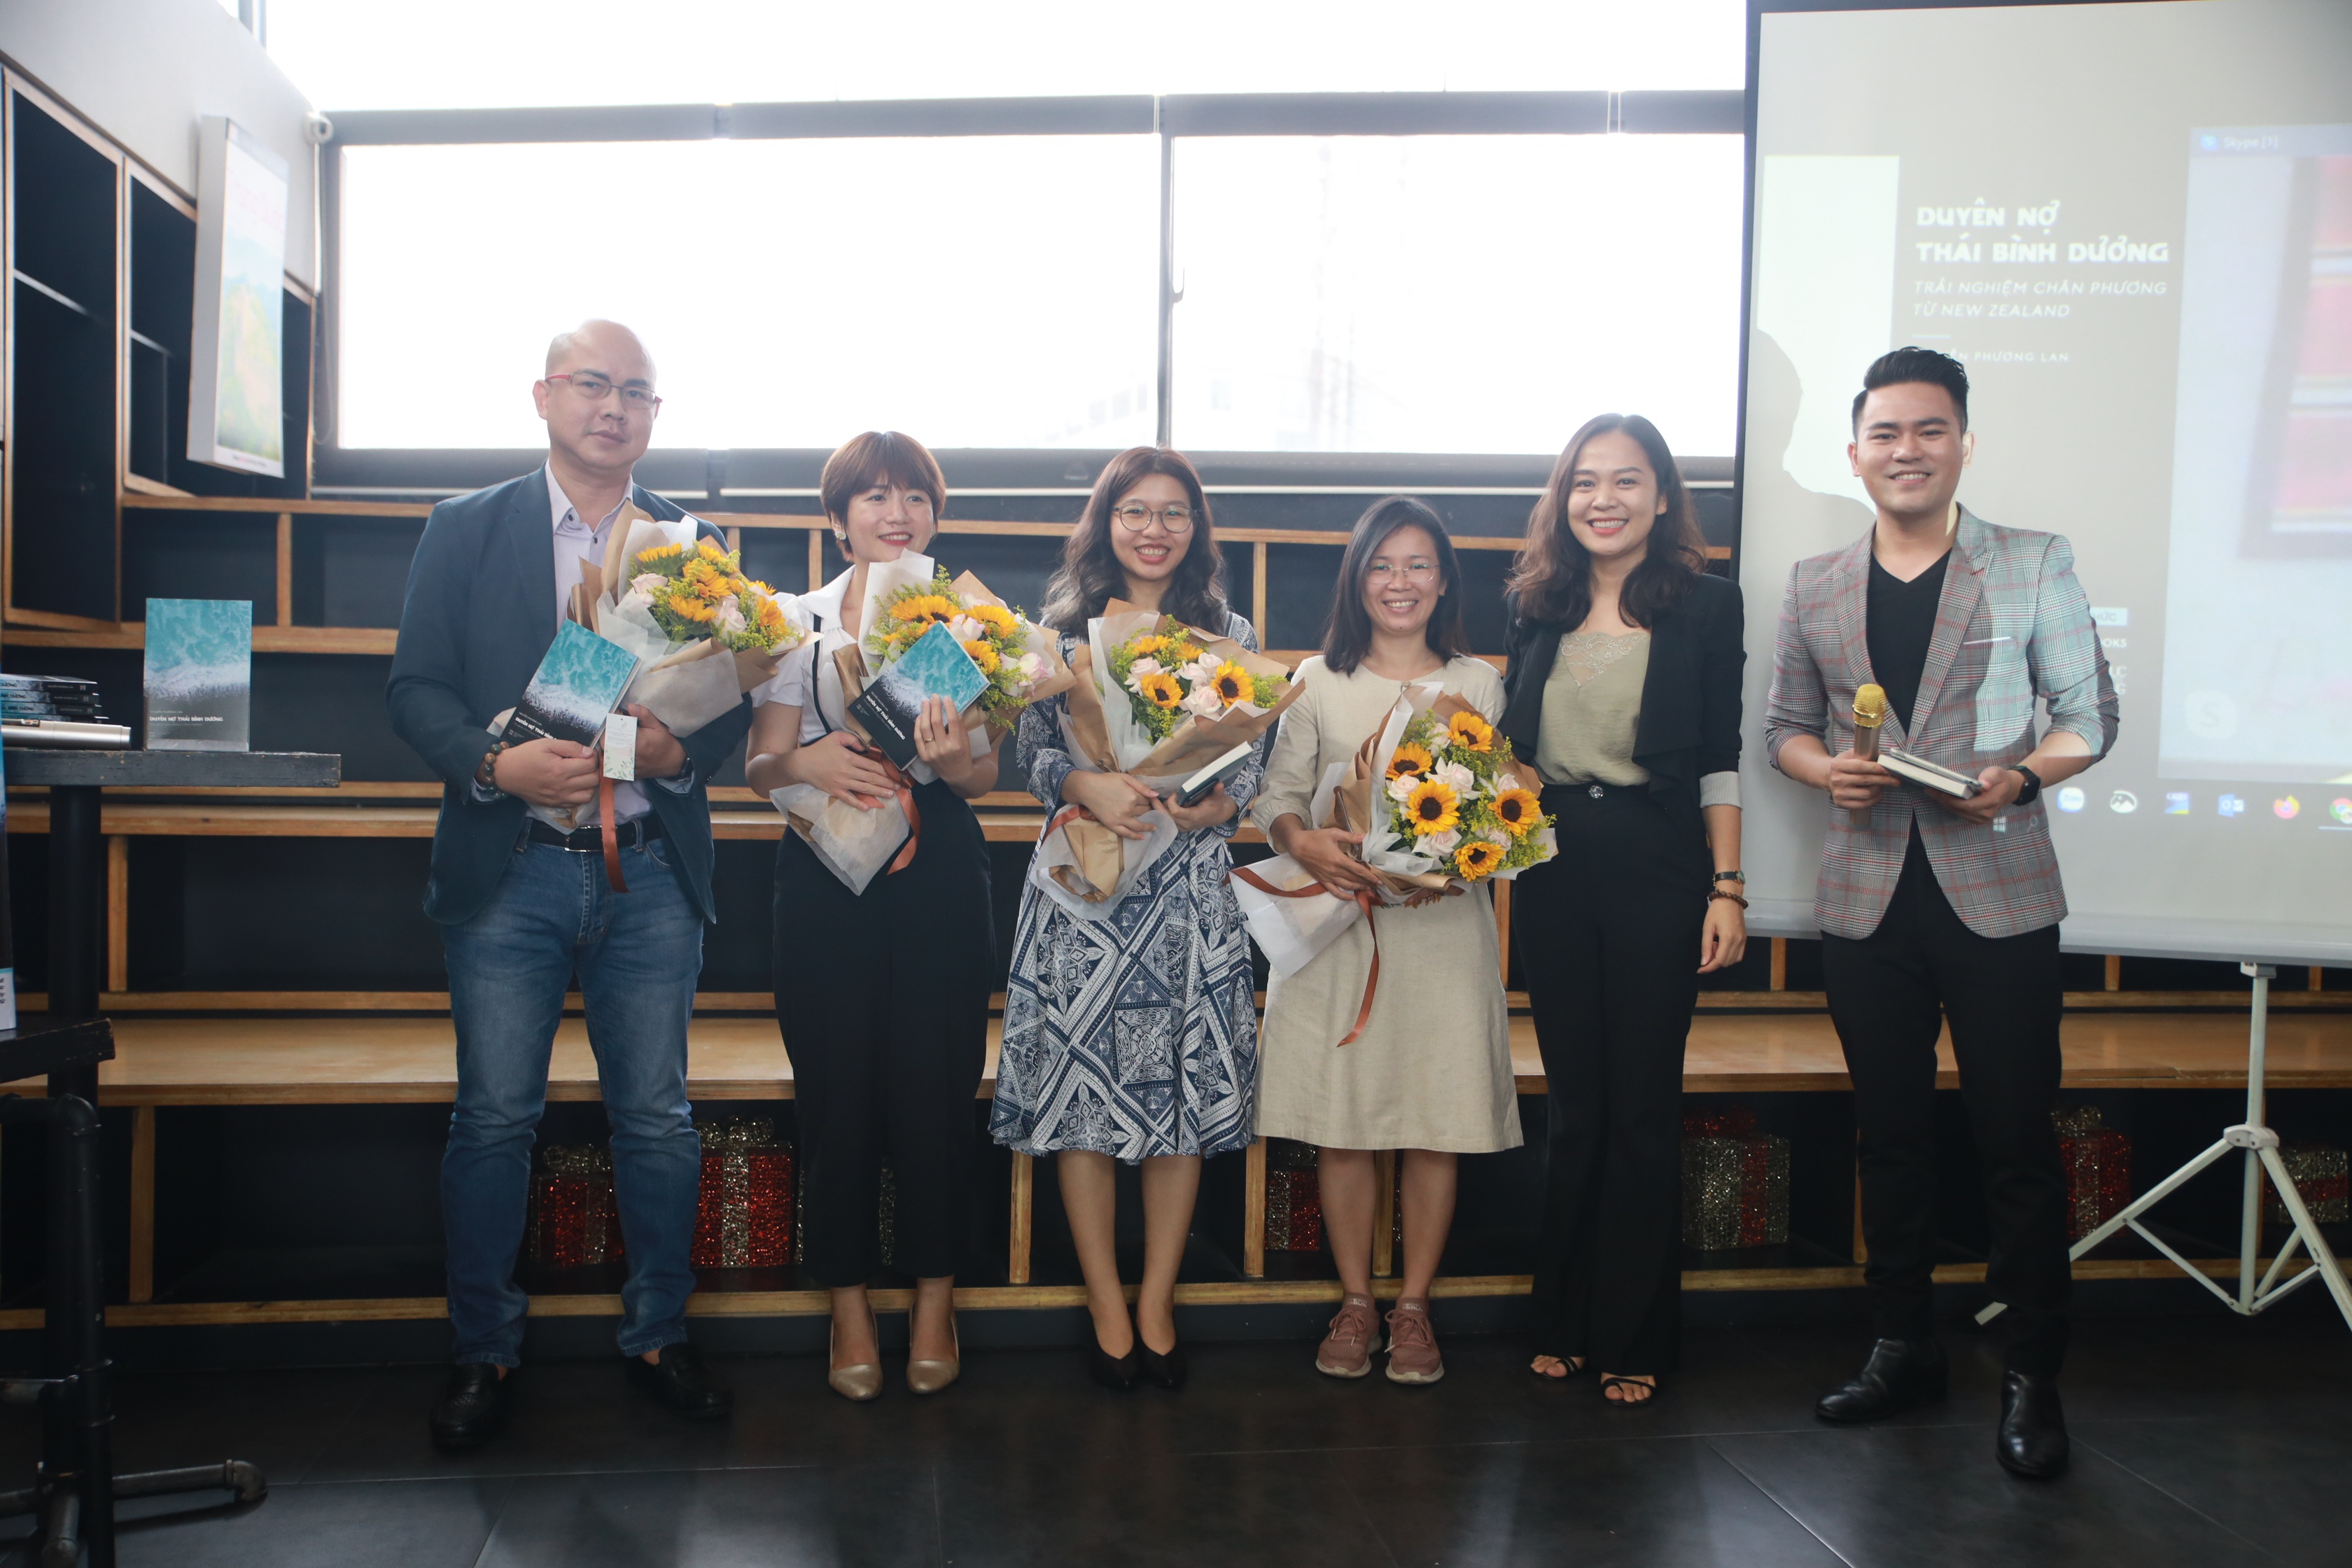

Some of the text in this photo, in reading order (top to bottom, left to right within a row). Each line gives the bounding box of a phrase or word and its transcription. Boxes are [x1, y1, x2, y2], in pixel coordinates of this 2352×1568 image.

[2224, 136, 2260, 150] Skype
[1917, 197, 2060, 235] DUYÊN NỢ
[1916, 232, 1981, 262] THÁI
[1992, 233, 2057, 262] BÌNH
[1914, 277, 1952, 293] TRẢI
[1958, 279, 2027, 298] NGHIỆM
[2090, 280, 2167, 295] PHƯƠNG
[1914, 300, 2070, 316] TỪ NEW ZEALAND
[1975, 350, 2034, 362] PHƯƠNG
[2041, 352, 2068, 362] LAN
[2101, 638, 2127, 648] OKS
